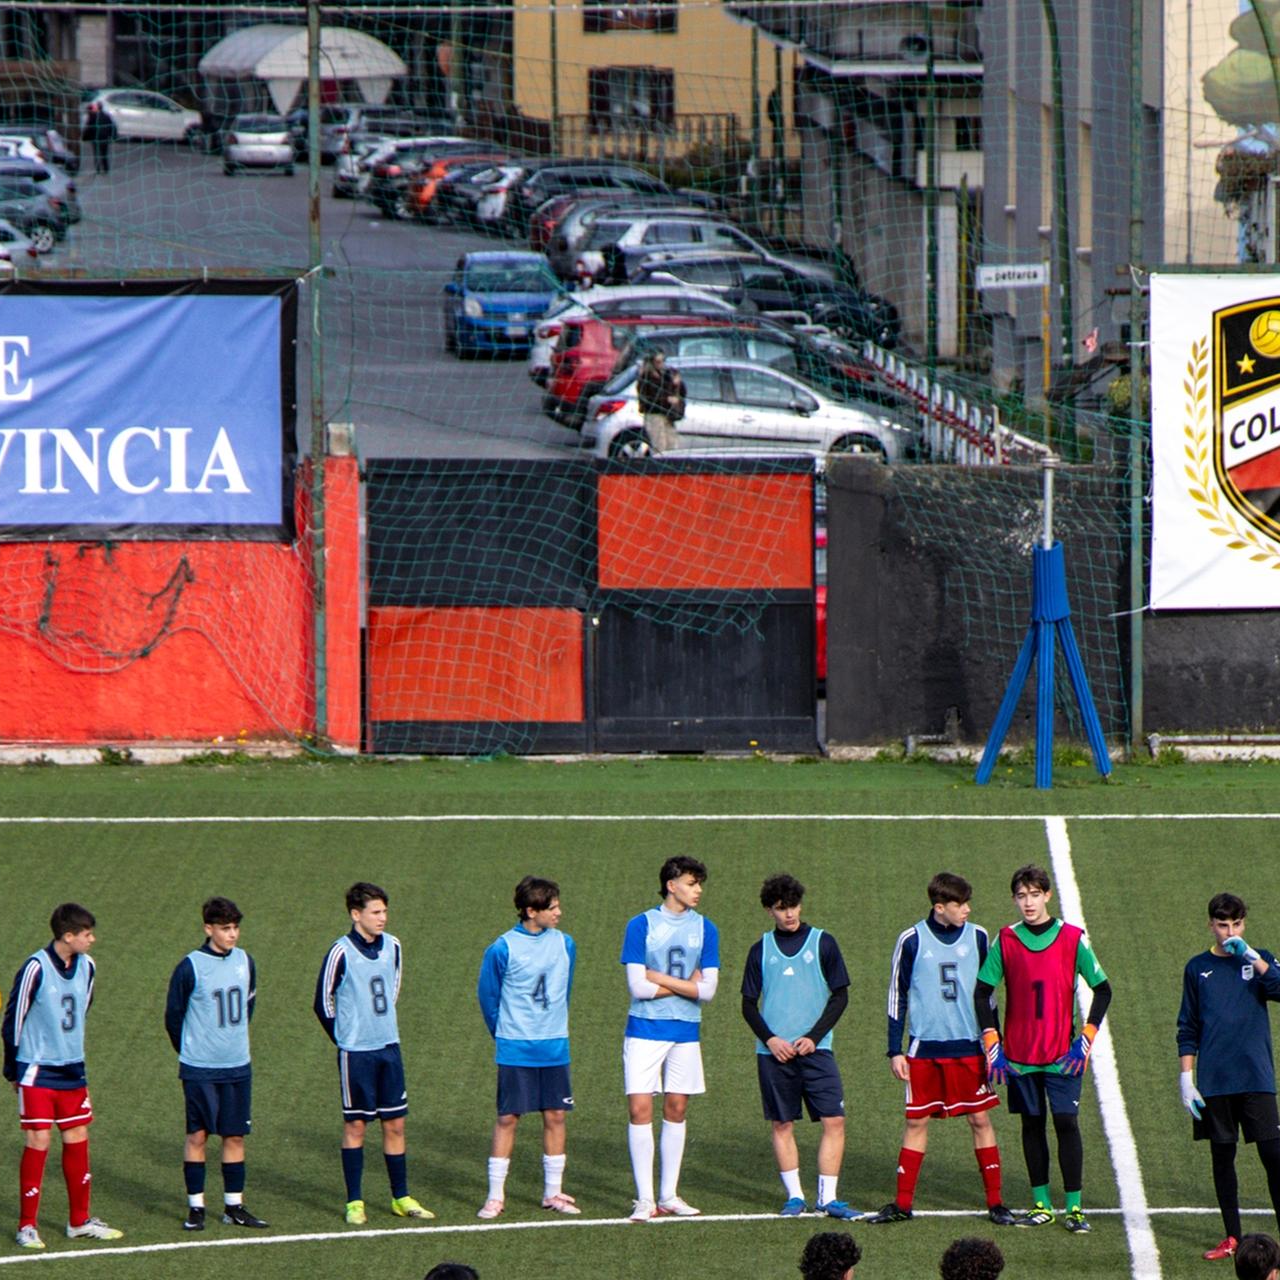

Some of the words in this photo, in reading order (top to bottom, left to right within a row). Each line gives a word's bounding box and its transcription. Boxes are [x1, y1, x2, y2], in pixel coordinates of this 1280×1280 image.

[371, 975, 388, 1016] 8
[532, 974, 549, 1010] 4
[939, 962, 958, 1002] 5
[1031, 980, 1045, 1020] 1
[61, 995, 76, 1031] 3
[211, 986, 242, 1028] 10
